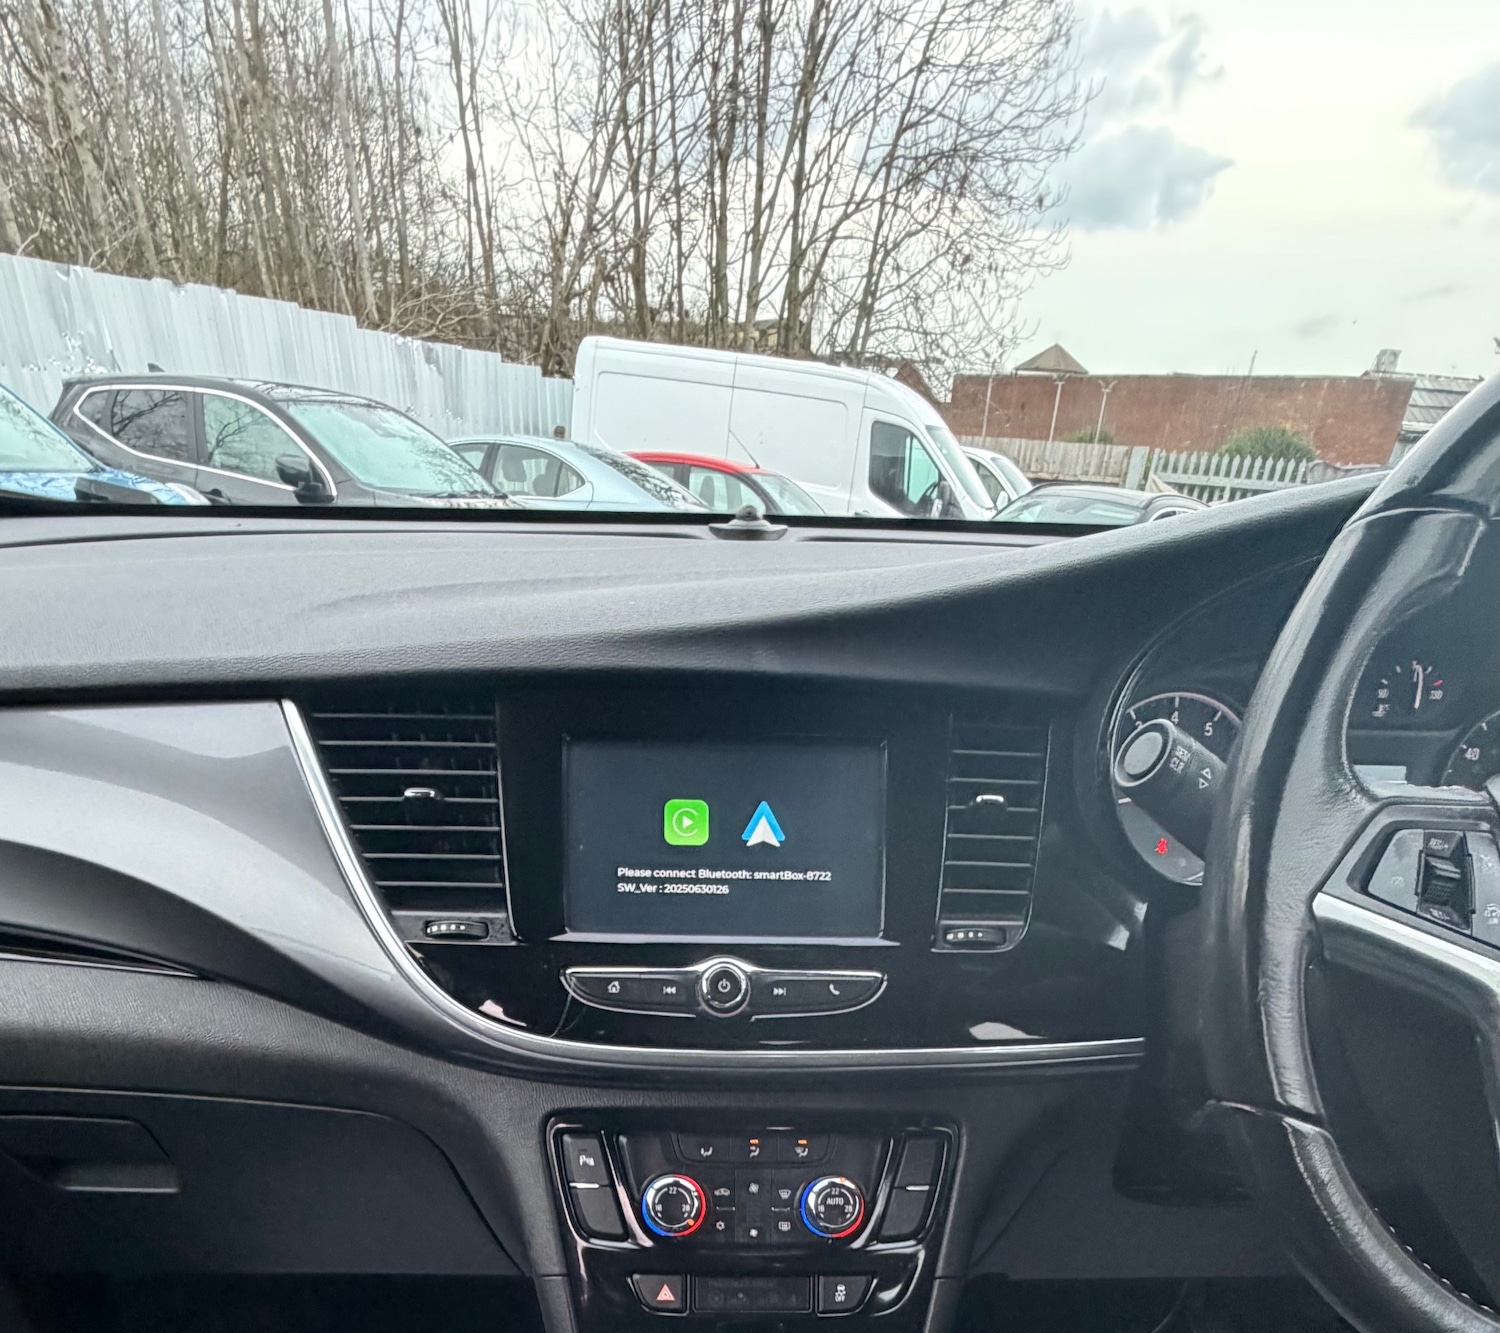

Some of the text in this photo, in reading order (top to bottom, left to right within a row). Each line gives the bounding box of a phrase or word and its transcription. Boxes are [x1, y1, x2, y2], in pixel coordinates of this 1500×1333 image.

[1170, 711, 1179, 724] 4
[1204, 722, 1213, 736] 5
[617, 867, 832, 881] Please connect Bluetooth: smartBox-8722
[617, 883, 658, 893] SW_Ver
[664, 883, 730, 894] 20250630126
[668, 1186, 677, 1194] 22
[831, 1187, 840, 1195] 22
[826, 1197, 844, 1205] AUTO
